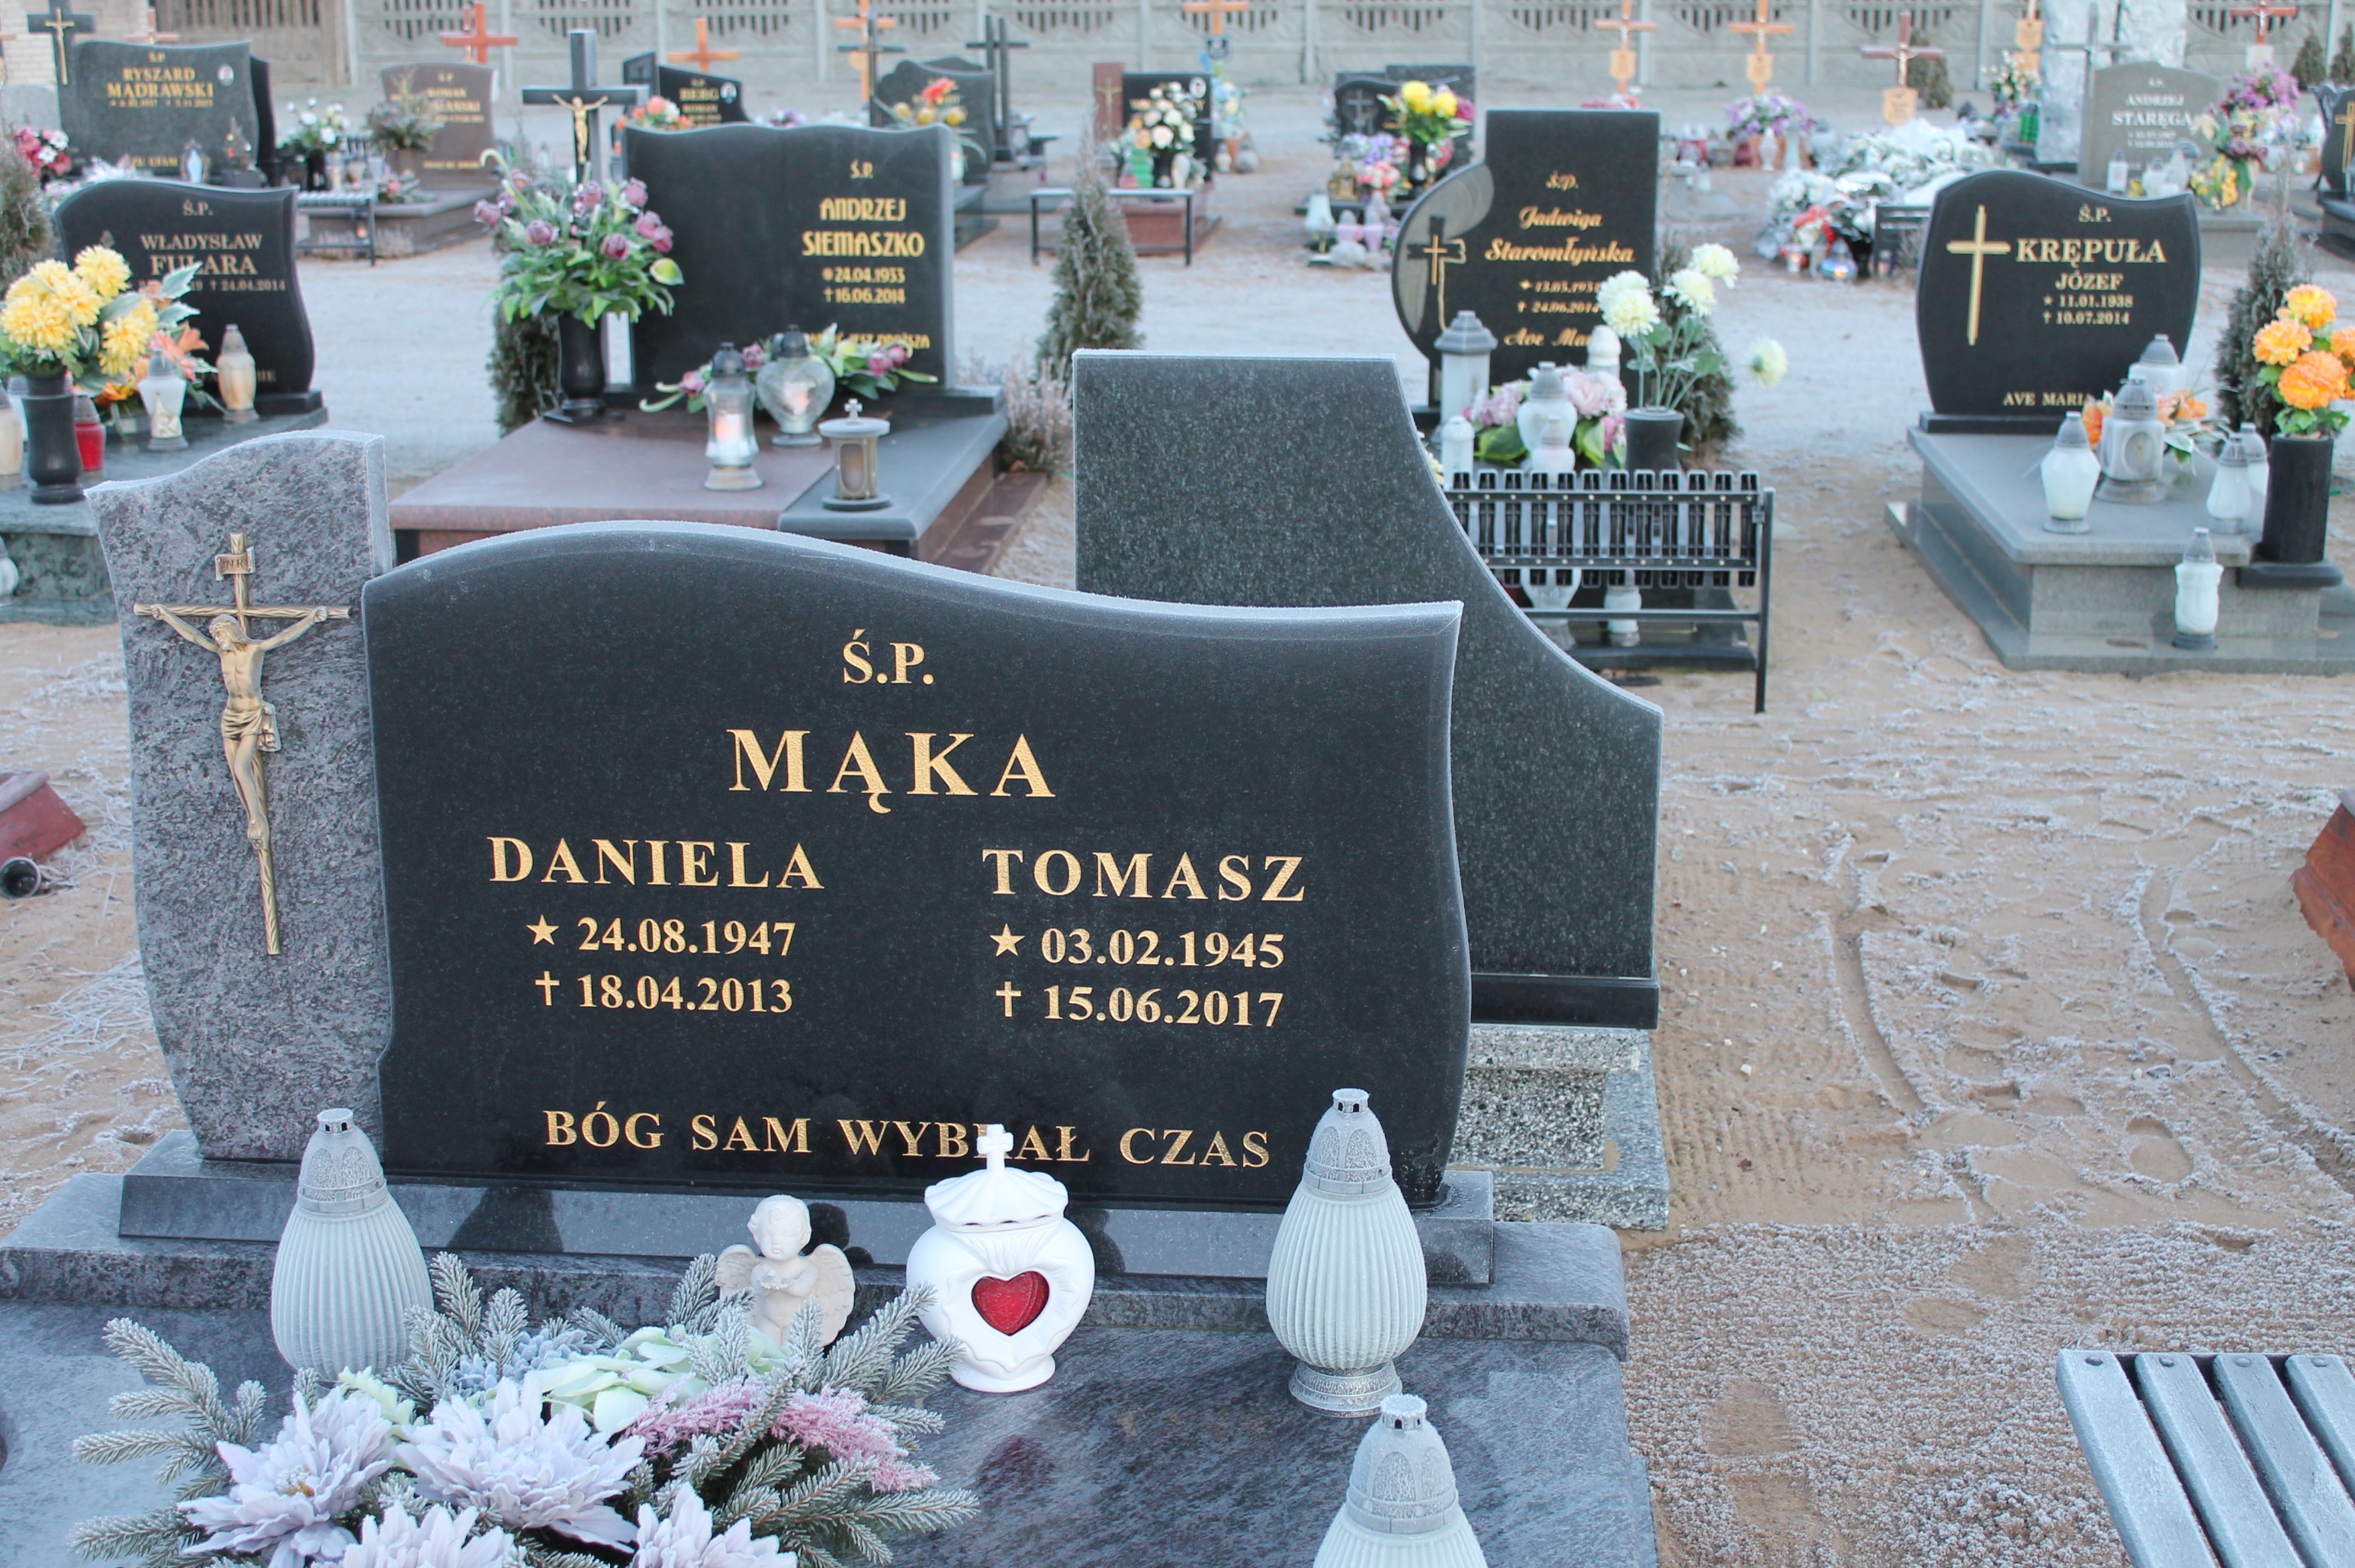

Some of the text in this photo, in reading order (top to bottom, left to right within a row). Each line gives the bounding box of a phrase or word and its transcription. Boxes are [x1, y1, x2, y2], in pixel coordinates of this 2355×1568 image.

[122, 67, 196, 82] RYSZARD
[107, 82, 214, 100] MĄDRAWSKI
[2126, 93, 2185, 107] ANDRZEJ
[2111, 110, 2194, 130] STARĘGA
[182, 198, 214, 217] Ś.P.
[819, 198, 907, 222] ANDRZEJ
[1518, 205, 1603, 230] Jadwiga
[2077, 203, 2112, 223] Ś.P.
[140, 233, 263, 251] WŁADYSŁAW
[802, 230, 925, 257] SIEMASZKO
[1484, 236, 1636, 267] Staromłyńska
[2015, 237, 2168, 268] KRĘPUŁA
[2054, 268, 2125, 291] JÓZEF
[1503, 326, 1546, 346] Ave
[2003, 391, 2036, 406] AVE
[843, 628, 936, 686] Ś.P.
[726, 729, 1057, 815] MĄKA
[487, 837, 826, 889] DANIELA
[982, 849, 1306, 903] TOMASZ
[577, 917, 797, 956] 24.08.1947
[1040, 927, 1286, 969] 03.02.1945
[577, 974, 794, 1014] 18.04.2013
[1043, 985, 1285, 1028] 15.06.2017
[542, 1100, 665, 1149] BÓG
[691, 1114, 813, 1154] SAM
[1119, 1127, 1271, 1168] CZAS
